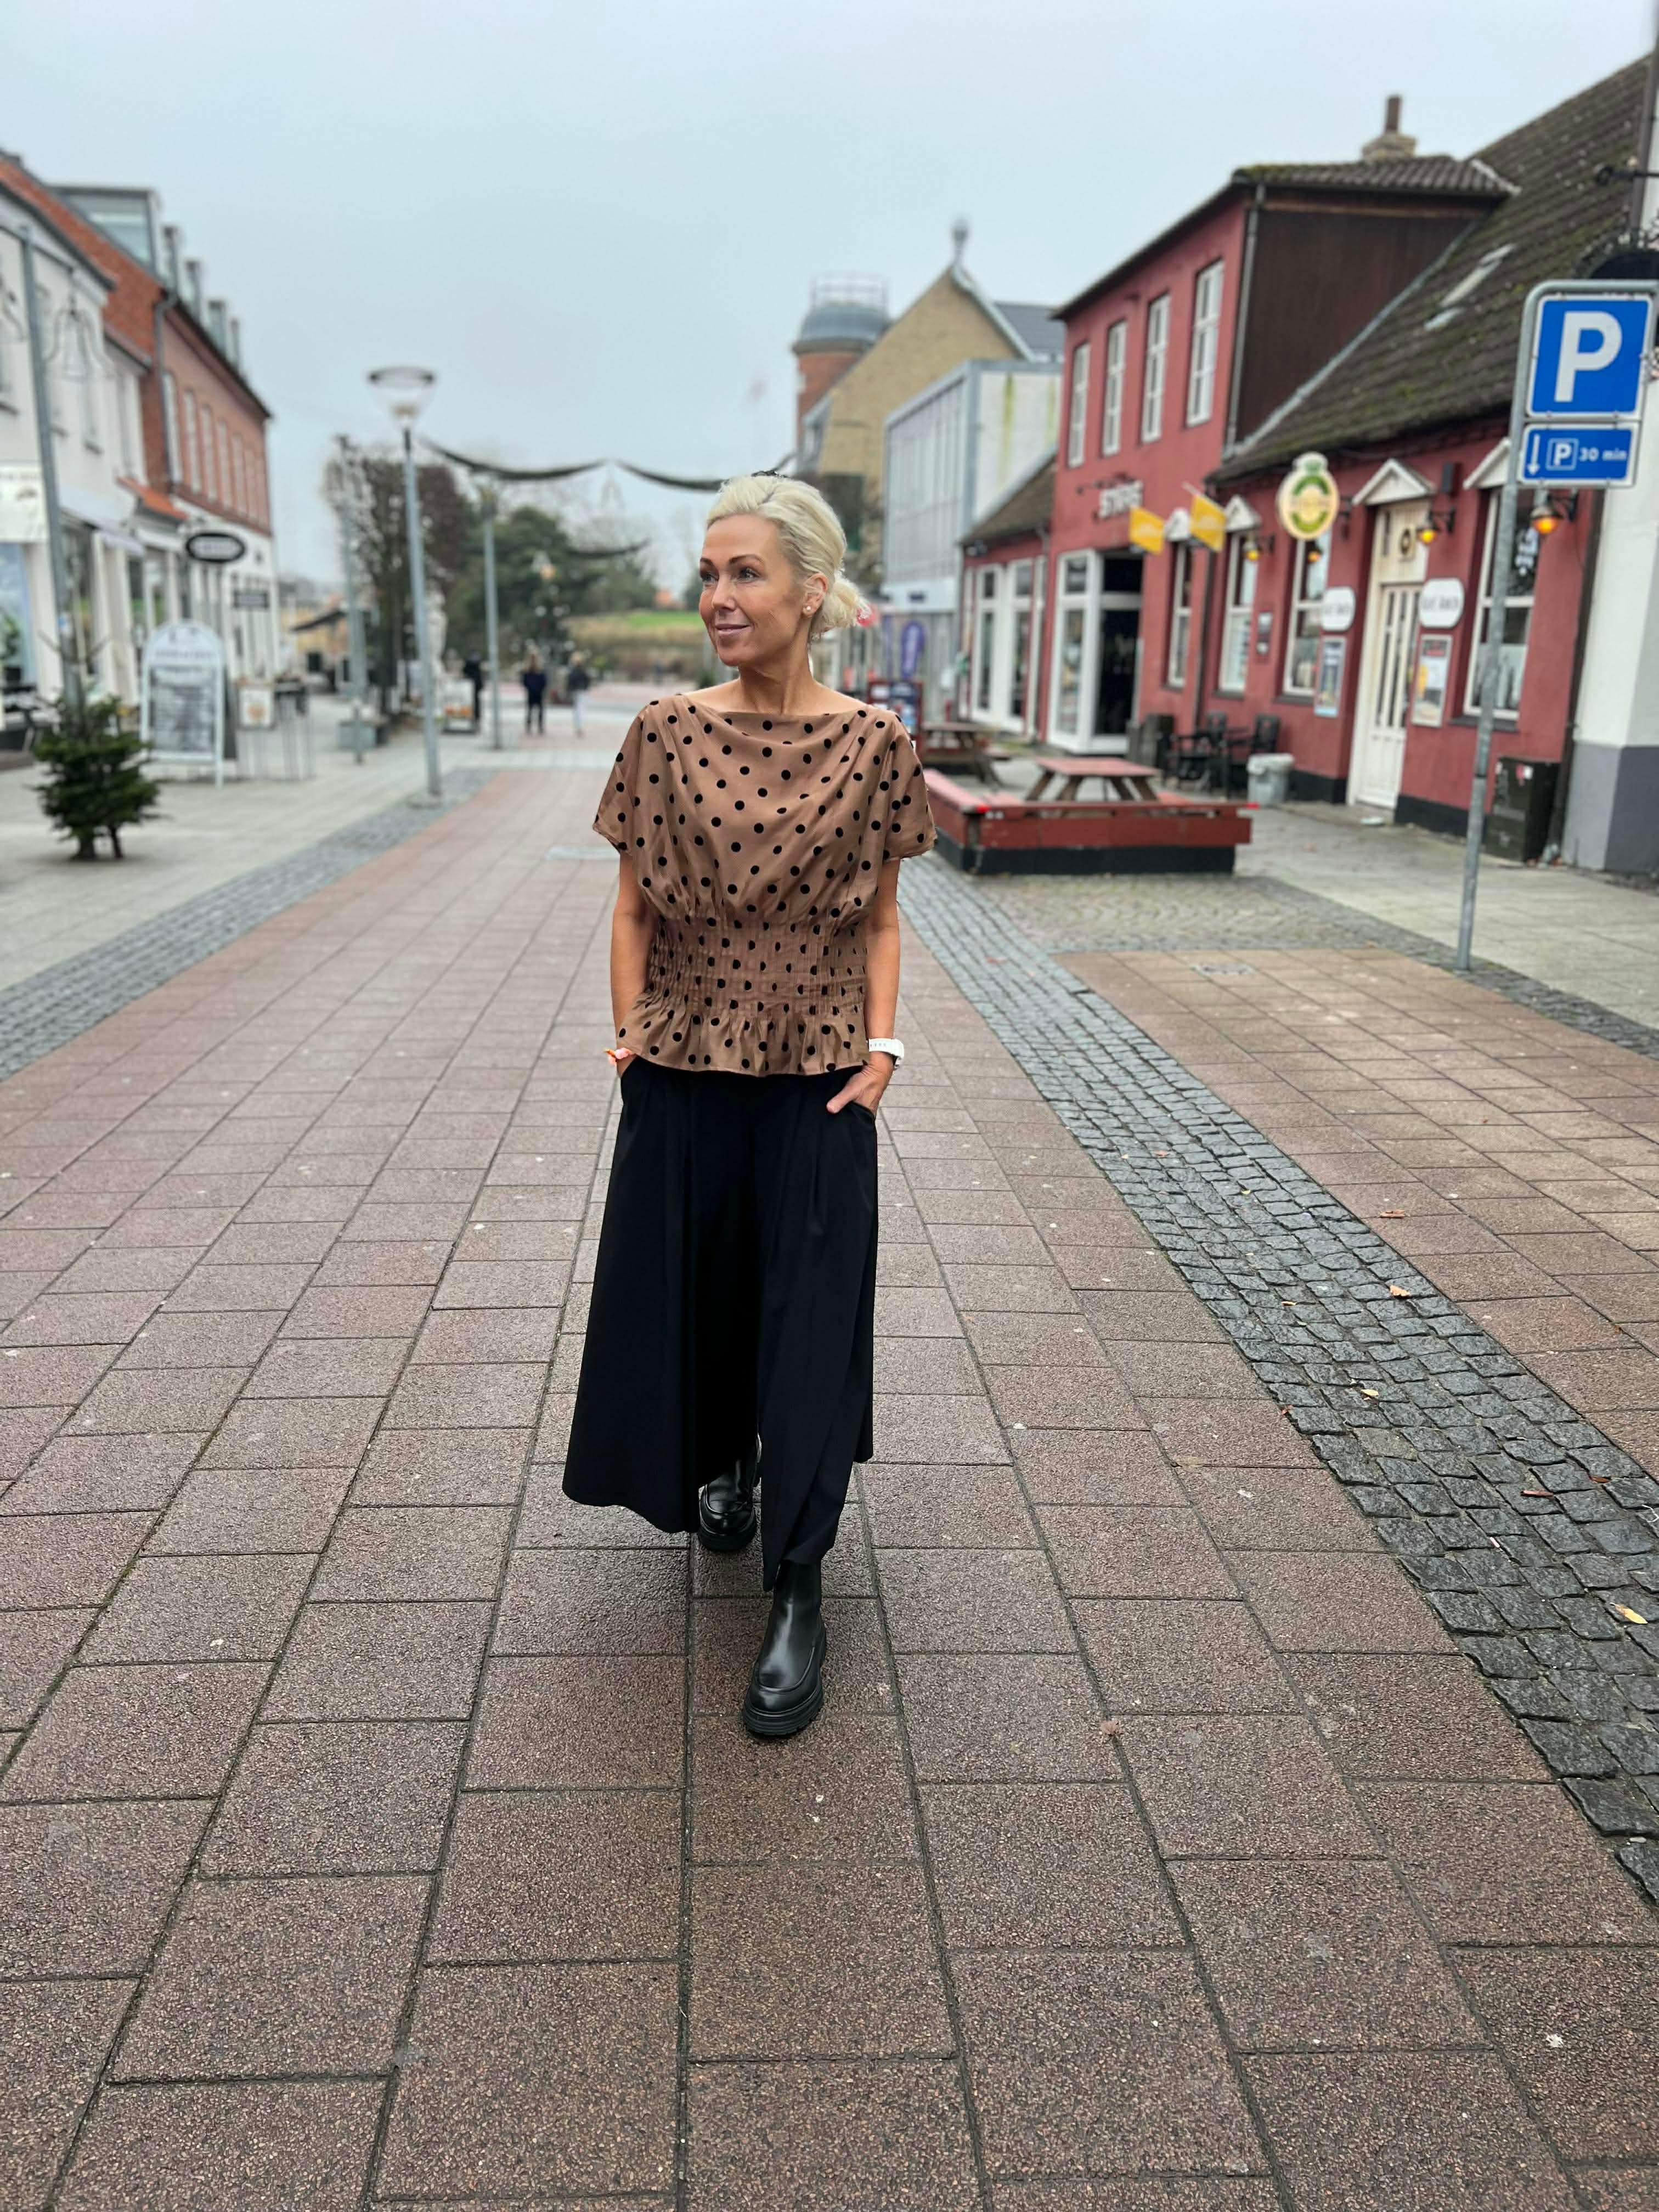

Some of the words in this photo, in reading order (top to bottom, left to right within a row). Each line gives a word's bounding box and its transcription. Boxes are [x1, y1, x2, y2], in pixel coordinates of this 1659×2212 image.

[1554, 311, 1622, 402] P
[1554, 443, 1572, 466] P
[1579, 447, 1599, 461] 30
[1602, 448, 1627, 461] min
